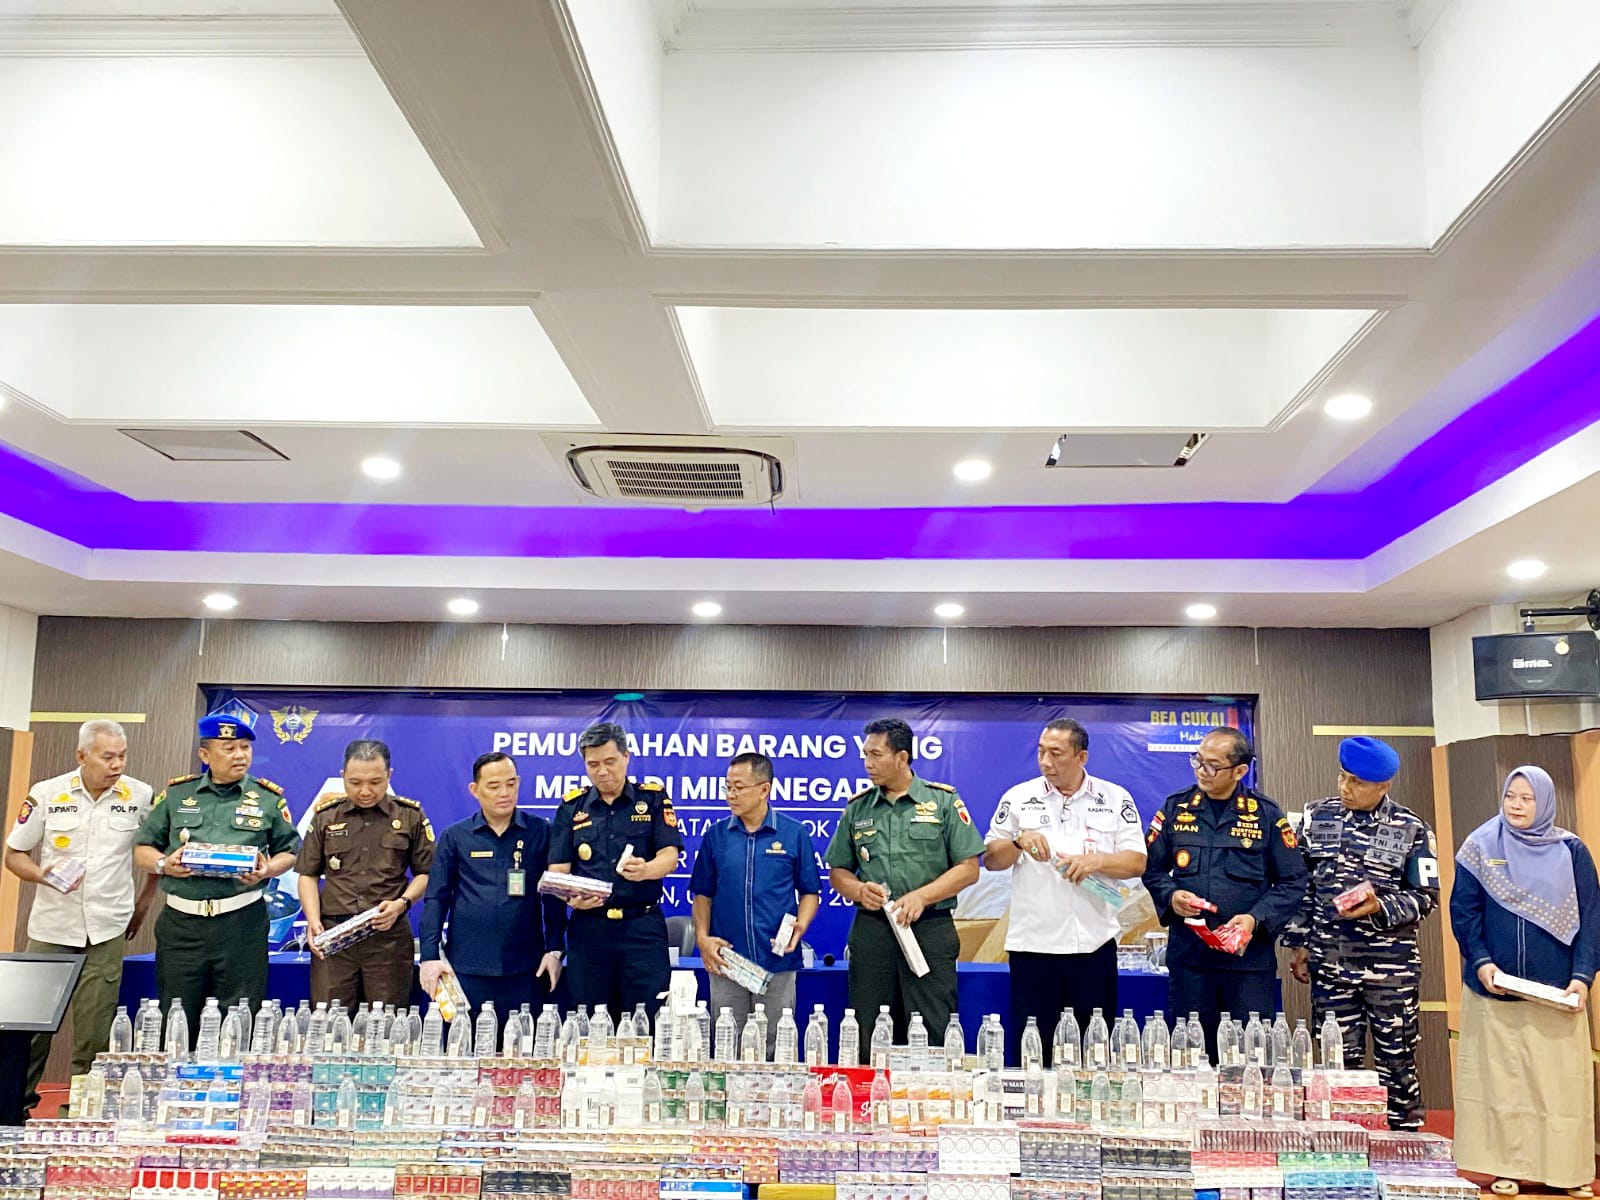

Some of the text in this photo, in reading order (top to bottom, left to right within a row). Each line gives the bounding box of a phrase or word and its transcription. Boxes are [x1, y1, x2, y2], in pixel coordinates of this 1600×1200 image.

[1150, 711, 1225, 726] BEA CUKAI
[493, 732, 710, 757] PEMUAHAN
[716, 734, 846, 758] BARANG
[770, 777, 874, 801] NEGAR
[110, 805, 138, 813] POL PP
[1173, 824, 1199, 832] VIAN
[1373, 839, 1405, 851] TNI AL
